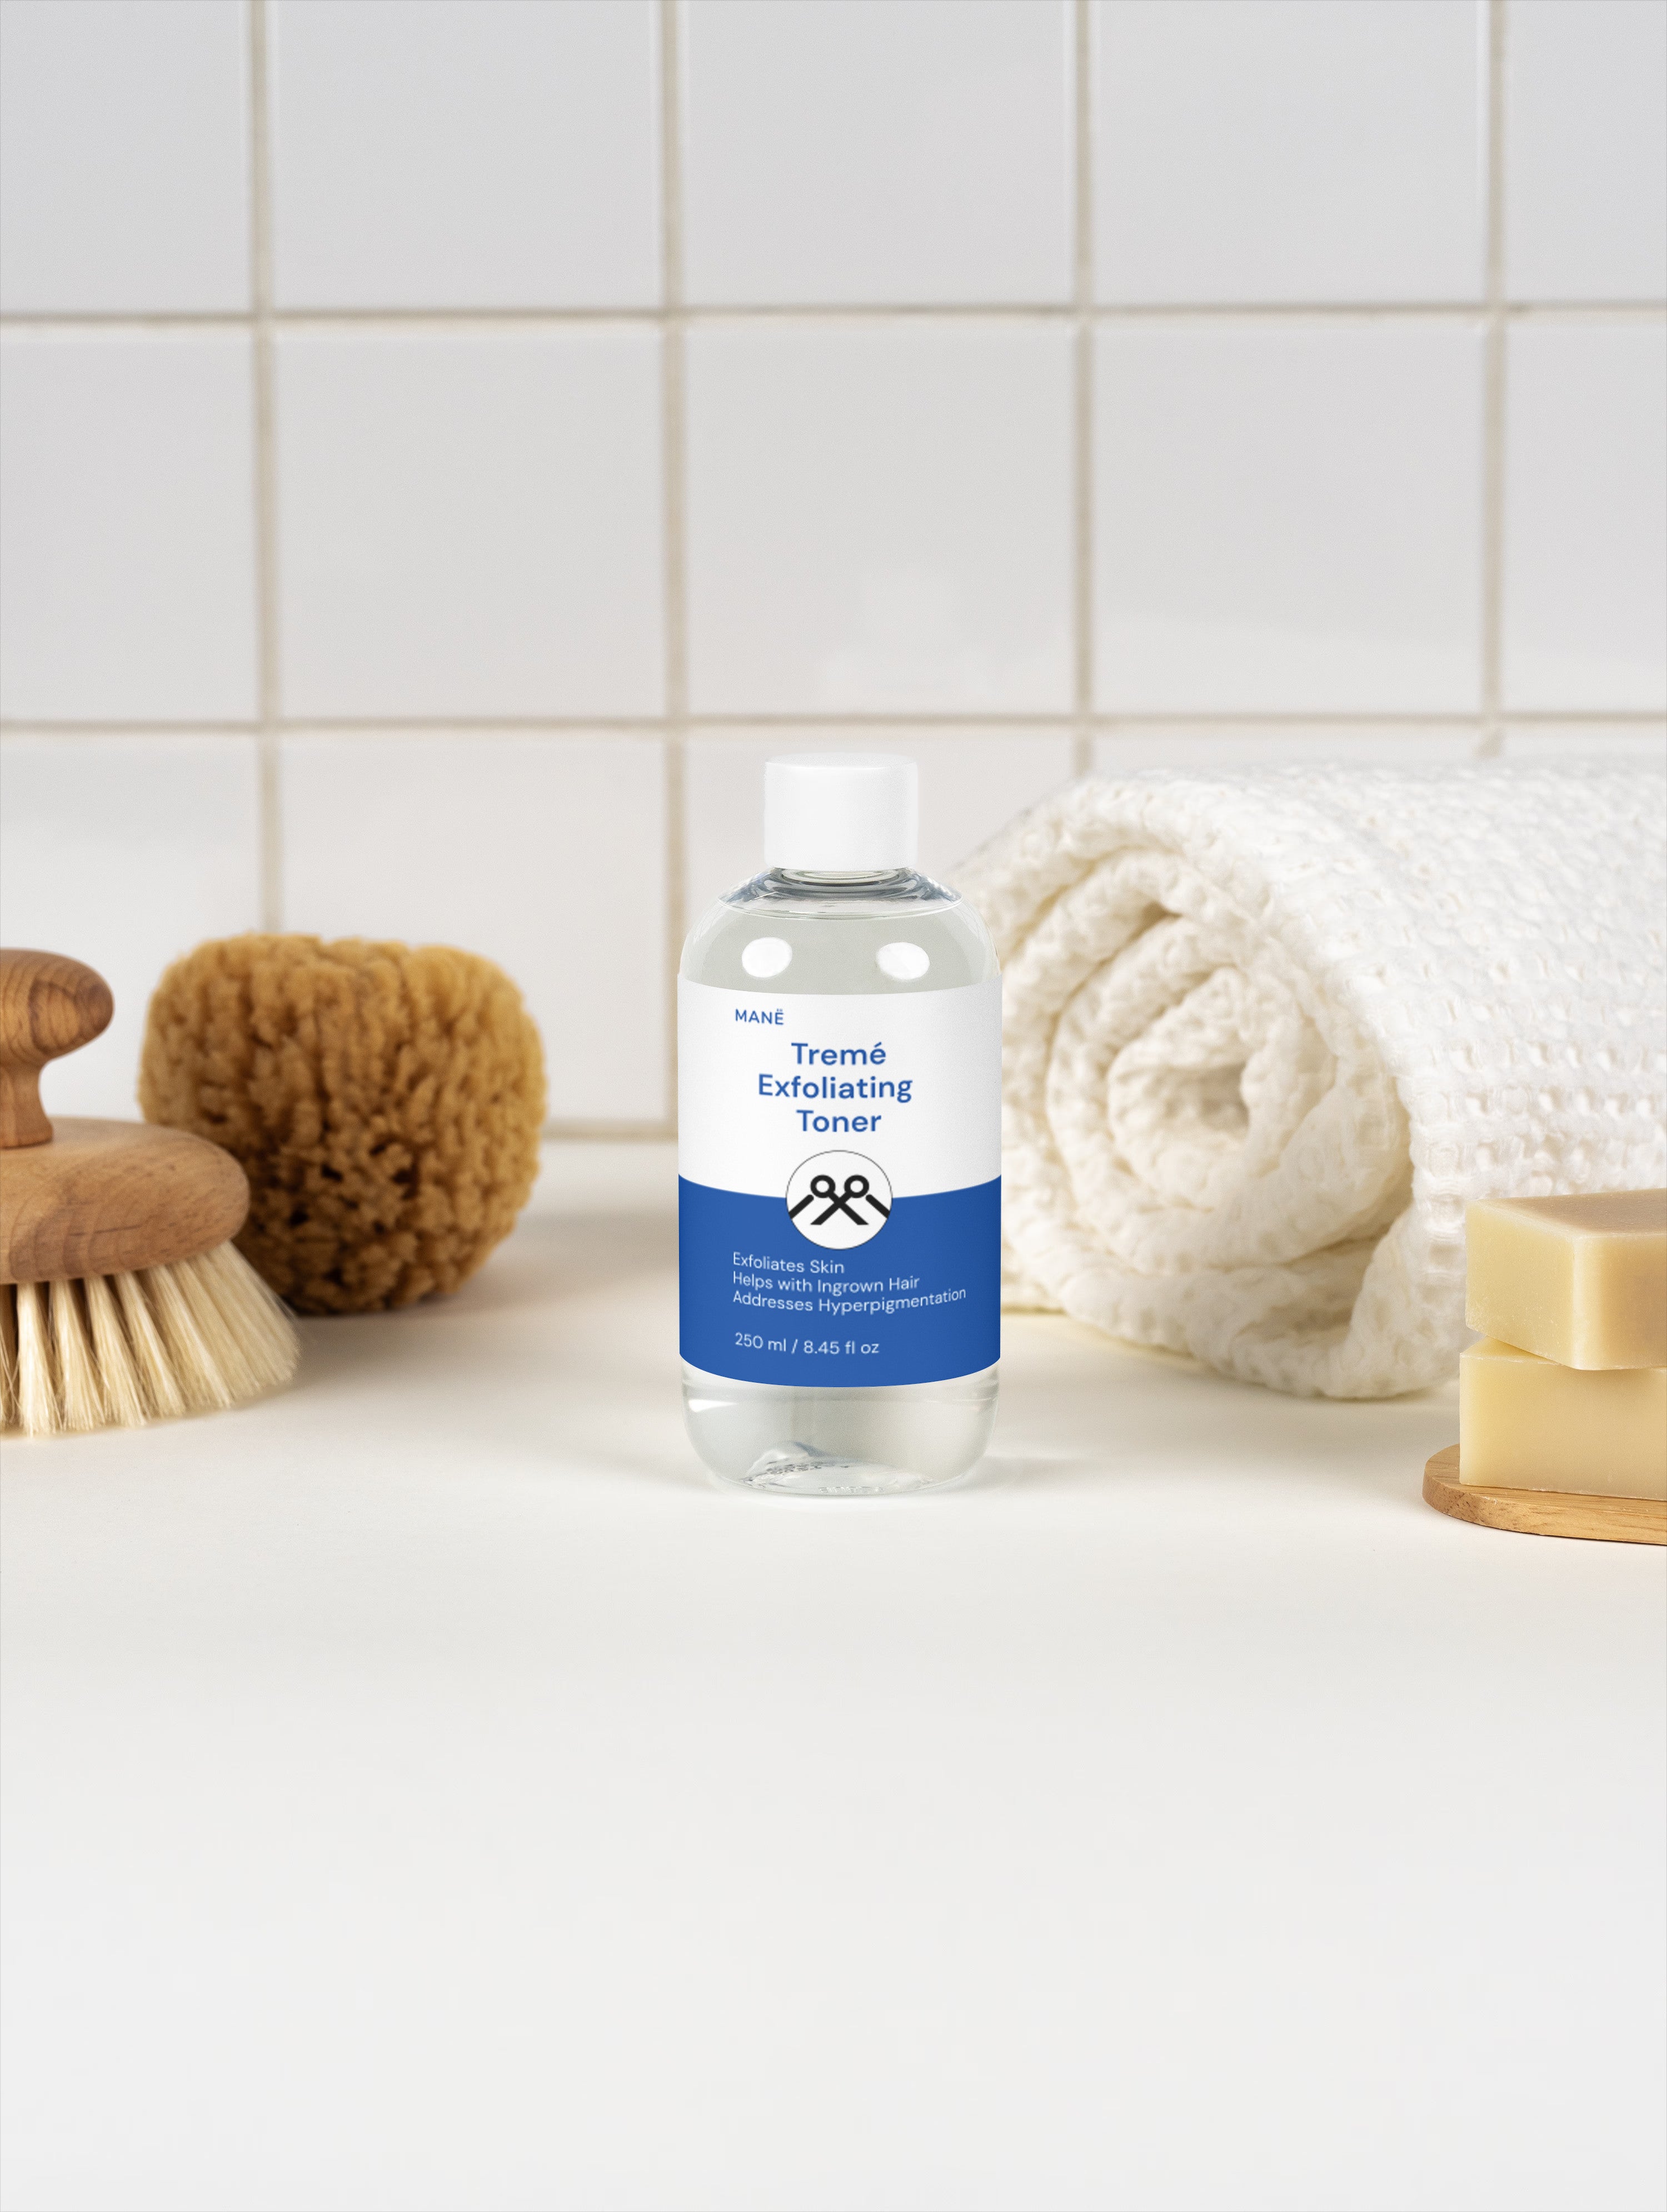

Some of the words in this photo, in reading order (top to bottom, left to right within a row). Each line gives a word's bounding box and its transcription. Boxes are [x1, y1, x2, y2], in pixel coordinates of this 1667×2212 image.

[735, 1008, 784, 1025] MANË
[791, 1042, 886, 1066] Tremé
[758, 1073, 913, 1103] Exfoliating
[796, 1109, 882, 1133] Toner
[733, 1252, 805, 1273] Exfoliates
[810, 1259, 845, 1274] Skin
[733, 1271, 773, 1291] Helps
[777, 1278, 812, 1292] with
[817, 1279, 884, 1297] Ingrown
[889, 1276, 920, 1291] Hair
[733, 1290, 813, 1311] Addresses
[819, 1288, 966, 1316] Hyperpigmentation
[735, 1332, 763, 1349] 250
[768, 1338, 786, 1352] ml
[791, 1339, 798, 1354] /
[803, 1340, 840, 1354] 8.45
[845, 1341, 855, 1354] fl
[861, 1343, 879, 1354] oz
